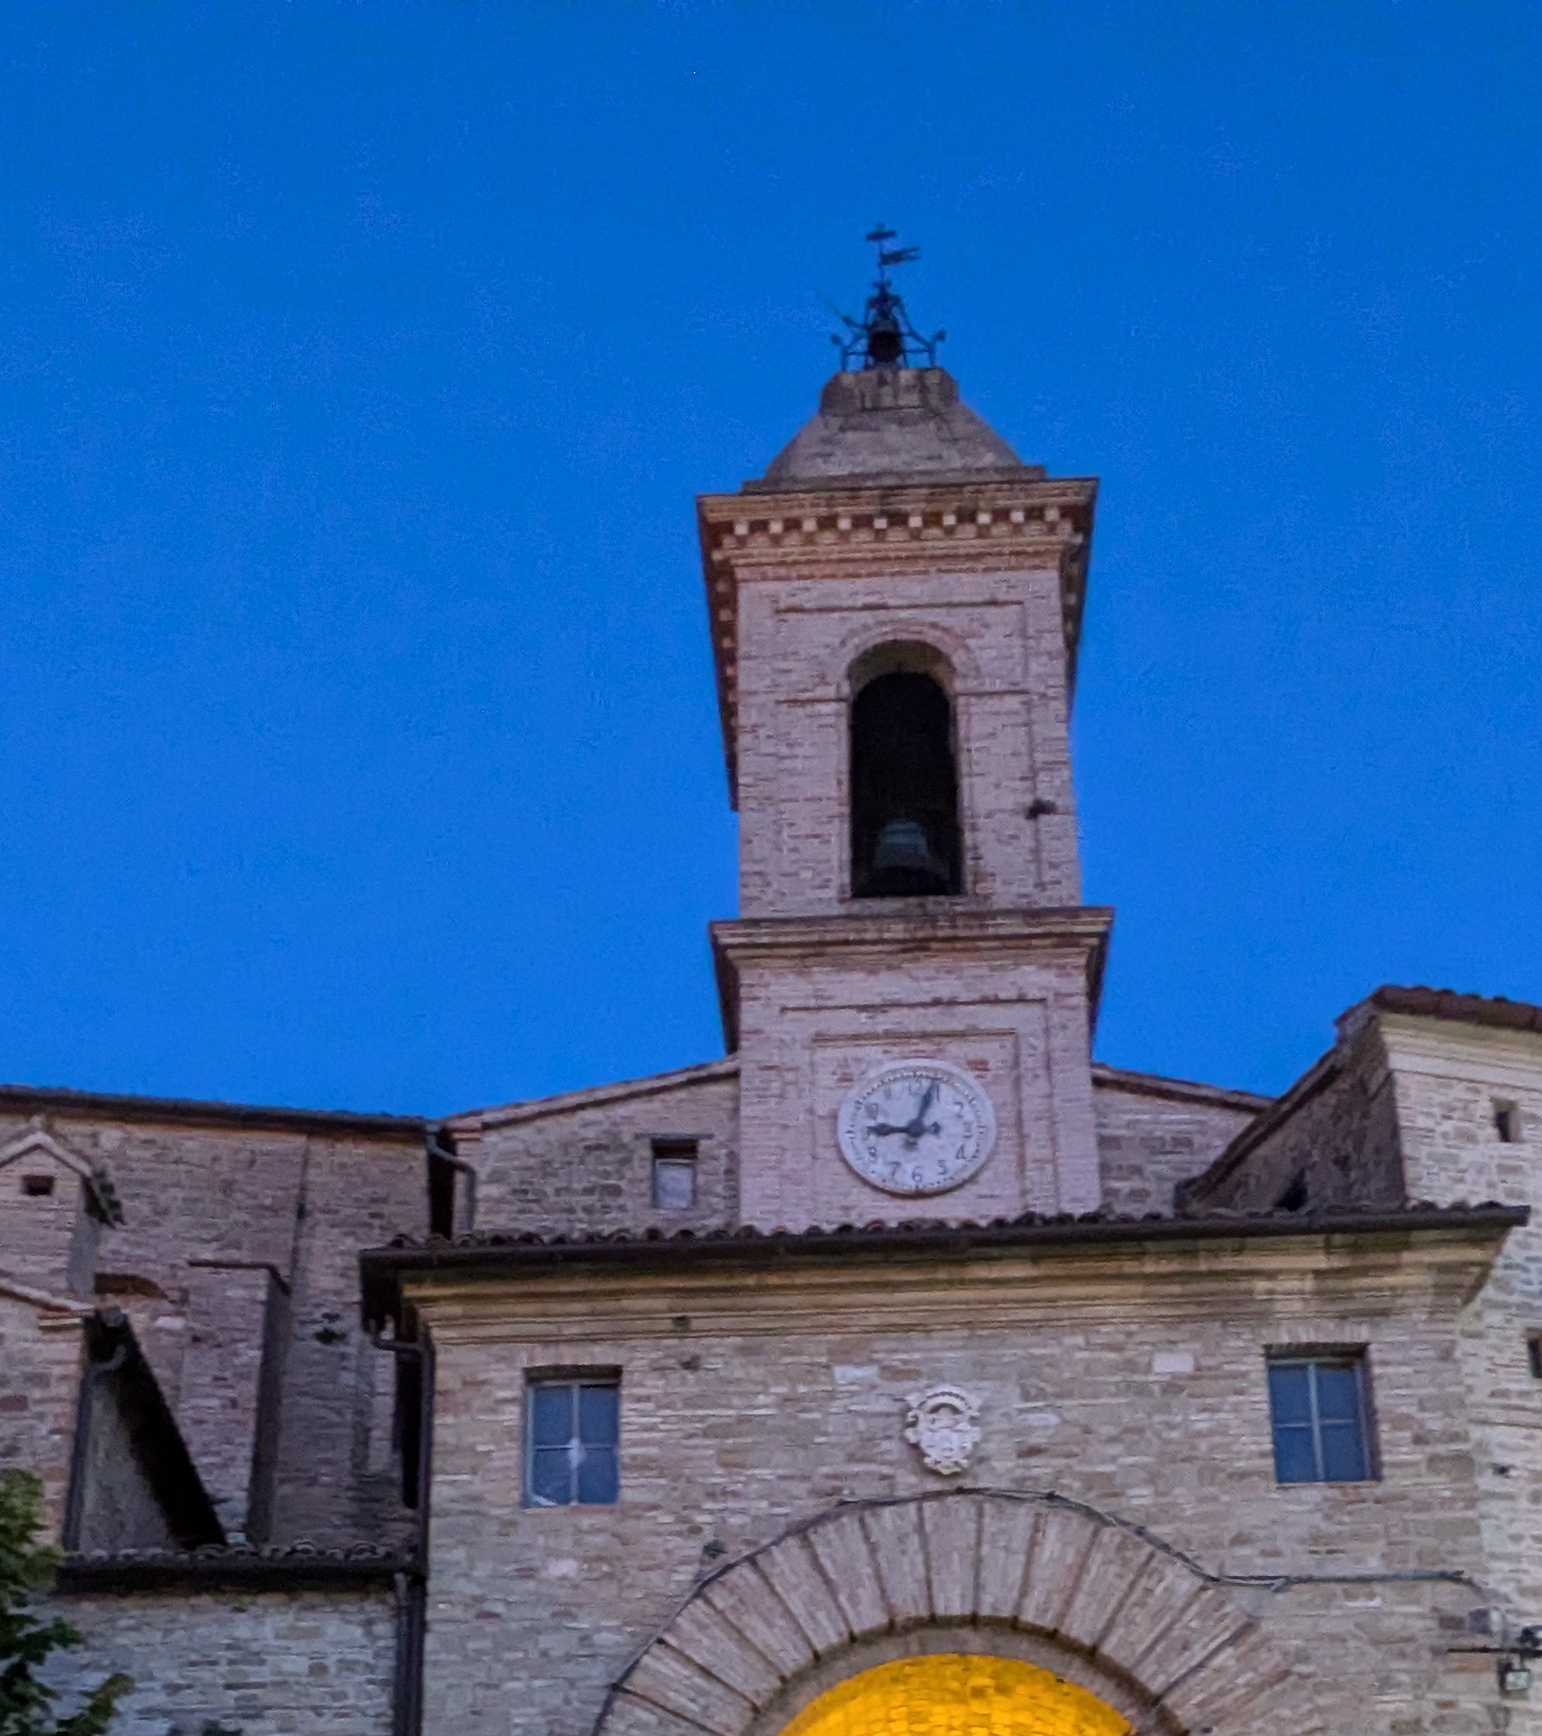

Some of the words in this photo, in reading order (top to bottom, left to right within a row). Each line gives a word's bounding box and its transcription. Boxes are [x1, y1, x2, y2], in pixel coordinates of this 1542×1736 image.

[955, 1144, 966, 1160] 4
[888, 1160, 901, 1179] 7
[911, 1165, 923, 1184] 6
